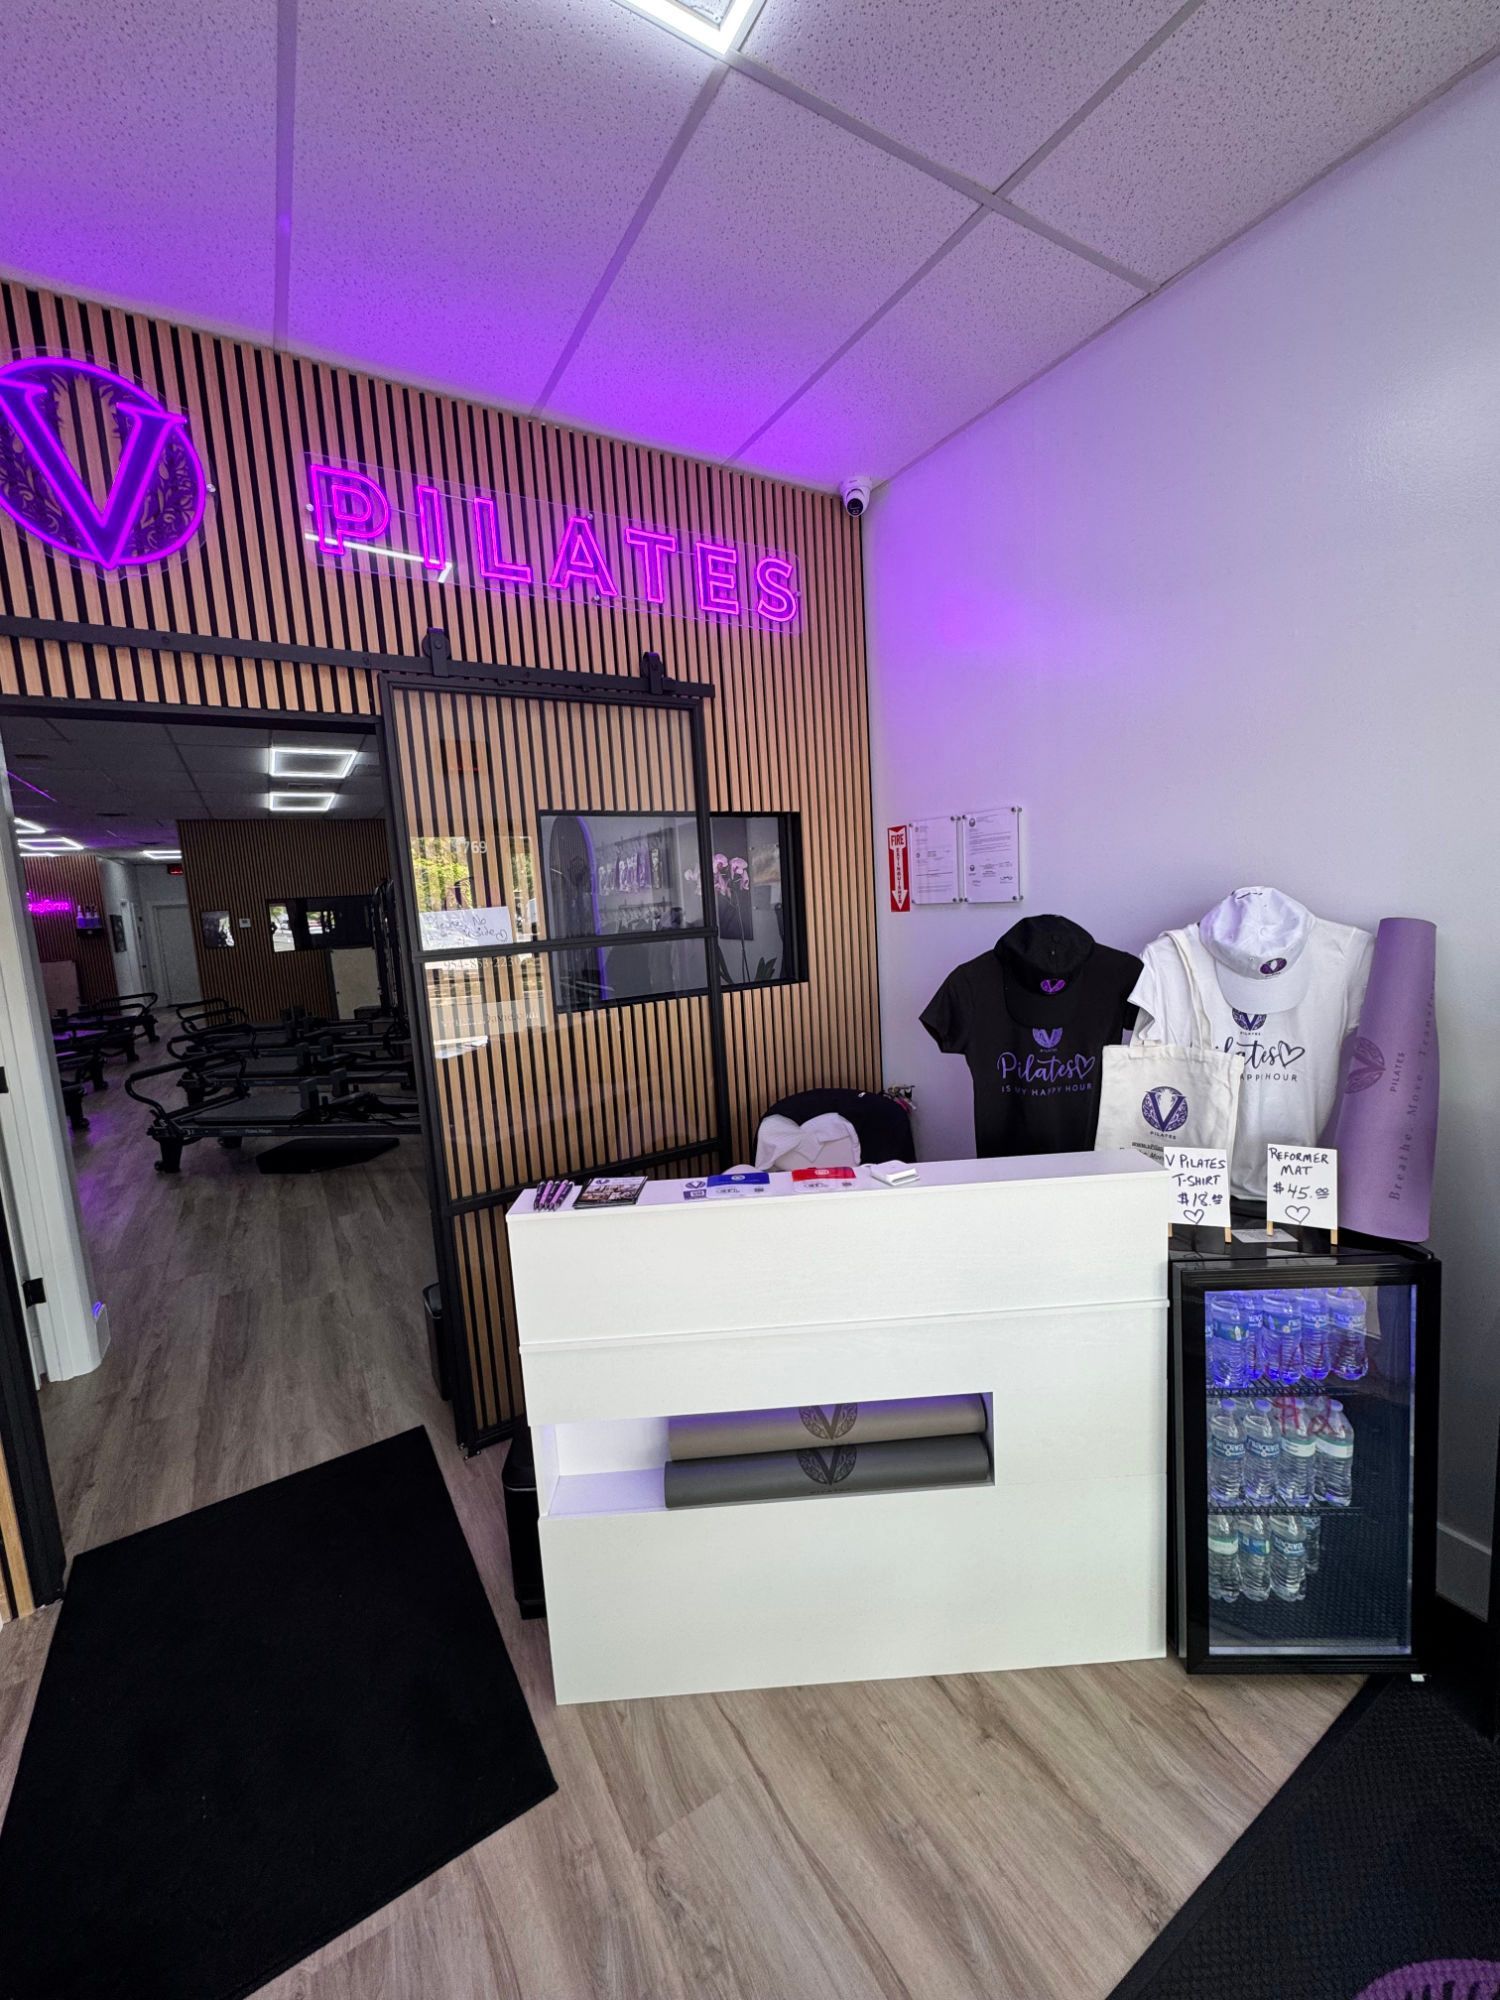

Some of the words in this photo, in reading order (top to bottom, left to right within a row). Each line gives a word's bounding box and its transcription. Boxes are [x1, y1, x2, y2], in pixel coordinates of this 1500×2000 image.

[0, 377, 188, 570] V
[312, 465, 797, 622] PILATES
[891, 834, 904, 846] FIRE
[997, 1051, 1076, 1082] Pilates
[1390, 1051, 1406, 1092] PILATES
[1265, 1072, 1298, 1082] HOUR
[1002, 1084, 1012, 1094] IS
[1031, 1086, 1062, 1097] HAPPY
[1065, 1082, 1092, 1093] HOUR
[1149, 1130, 1177, 1140] PILATES
[1165, 1154, 1176, 1167] V
[1180, 1153, 1226, 1169] PILATES
[1269, 1147, 1329, 1164] REFORMER
[1281, 1164, 1313, 1176] MAT
[1172, 1173, 1221, 1188] T-SHIRT
